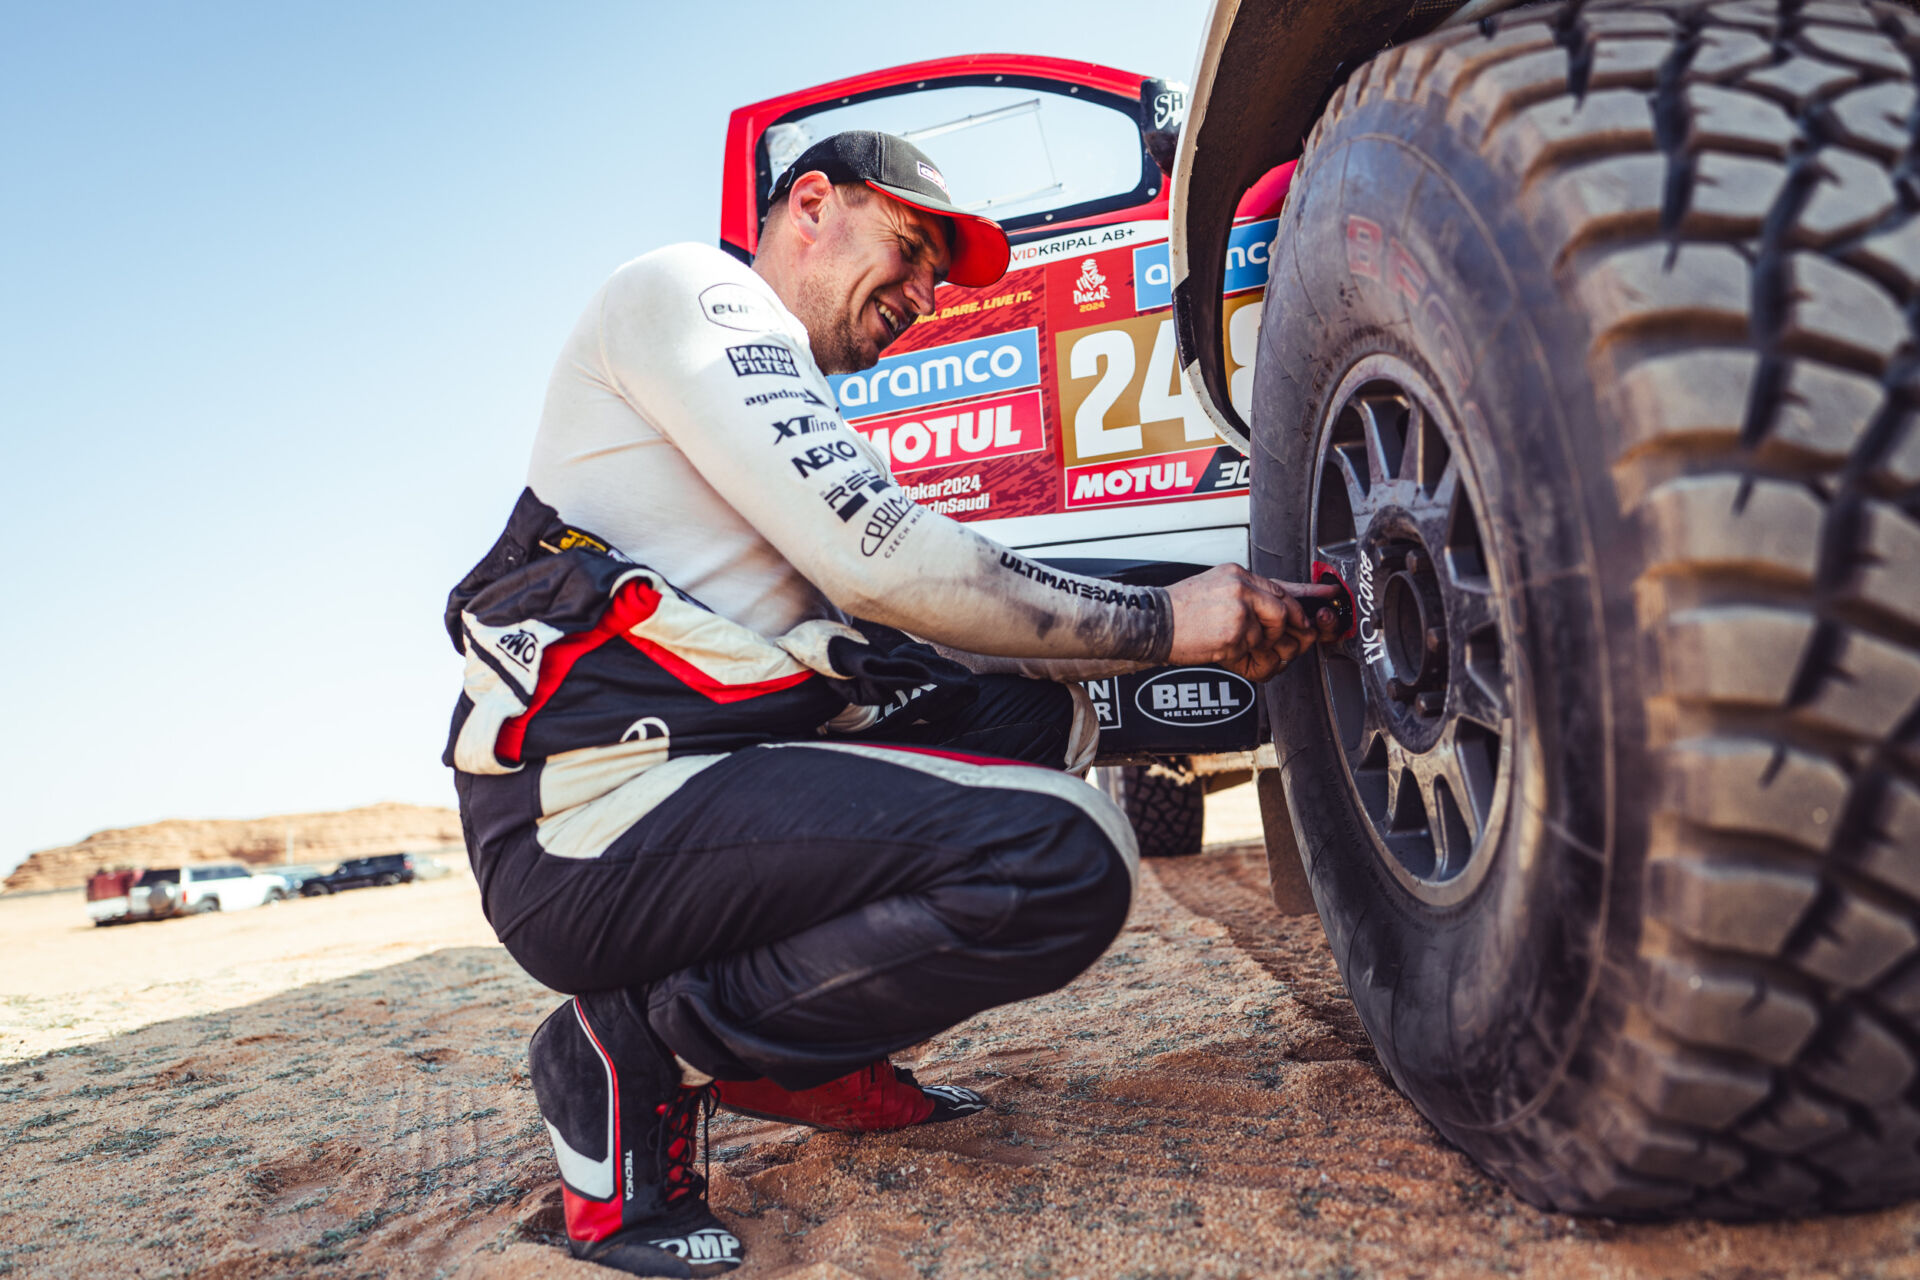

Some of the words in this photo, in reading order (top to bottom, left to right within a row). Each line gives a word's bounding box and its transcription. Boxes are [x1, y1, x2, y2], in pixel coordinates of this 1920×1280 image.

[1101, 229, 1135, 243] AB+
[940, 301, 981, 319] DARE.
[983, 293, 1015, 310] LIVE
[1015, 290, 1032, 303] IT.
[1072, 285, 1111, 305] DAKAR
[1079, 301, 1106, 313] 2024
[730, 345, 794, 364] MANN
[734, 360, 799, 377] FILTER
[839, 345, 1022, 407] aramco
[771, 414, 837, 446] XTline
[857, 404, 1022, 466] MOTUL
[791, 440, 857, 479] NEXO
[1072, 461, 1193, 500] MOTUL
[1152, 681, 1240, 710] BELL
[1163, 708, 1231, 718] HELMETS
[659, 1234, 741, 1259] OMP
